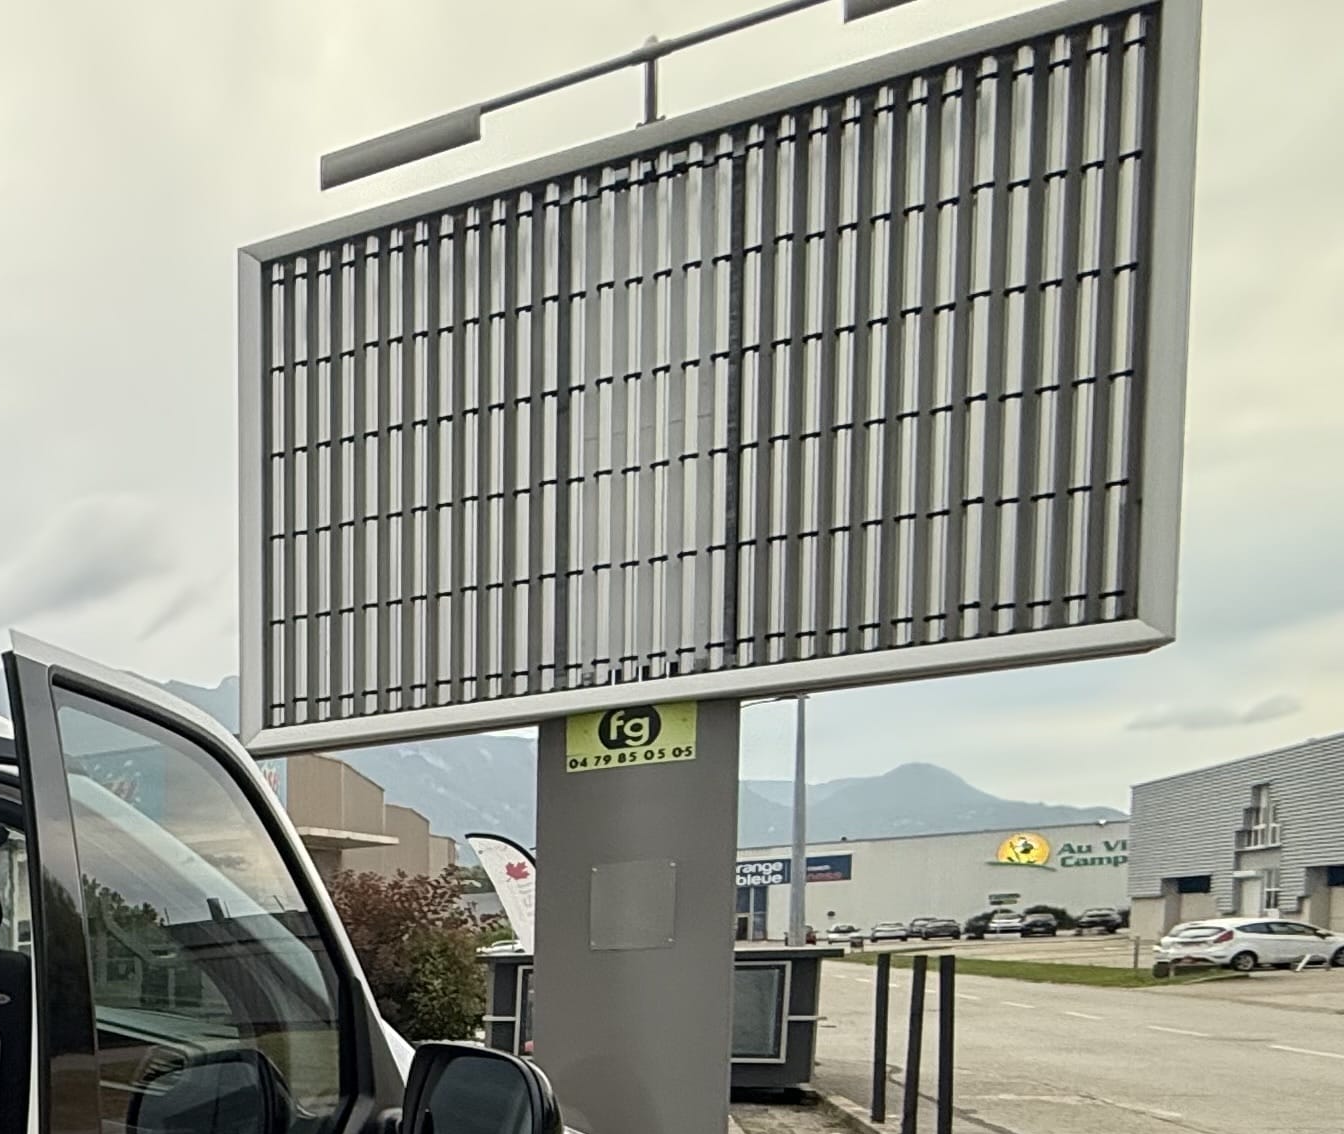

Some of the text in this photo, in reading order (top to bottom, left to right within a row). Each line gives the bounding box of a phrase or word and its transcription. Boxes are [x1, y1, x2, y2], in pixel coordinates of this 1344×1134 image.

[609, 710, 650, 746] fg
[568, 757, 588, 770] 04
[593, 754, 612, 766] 79
[617, 752, 638, 764] 85
